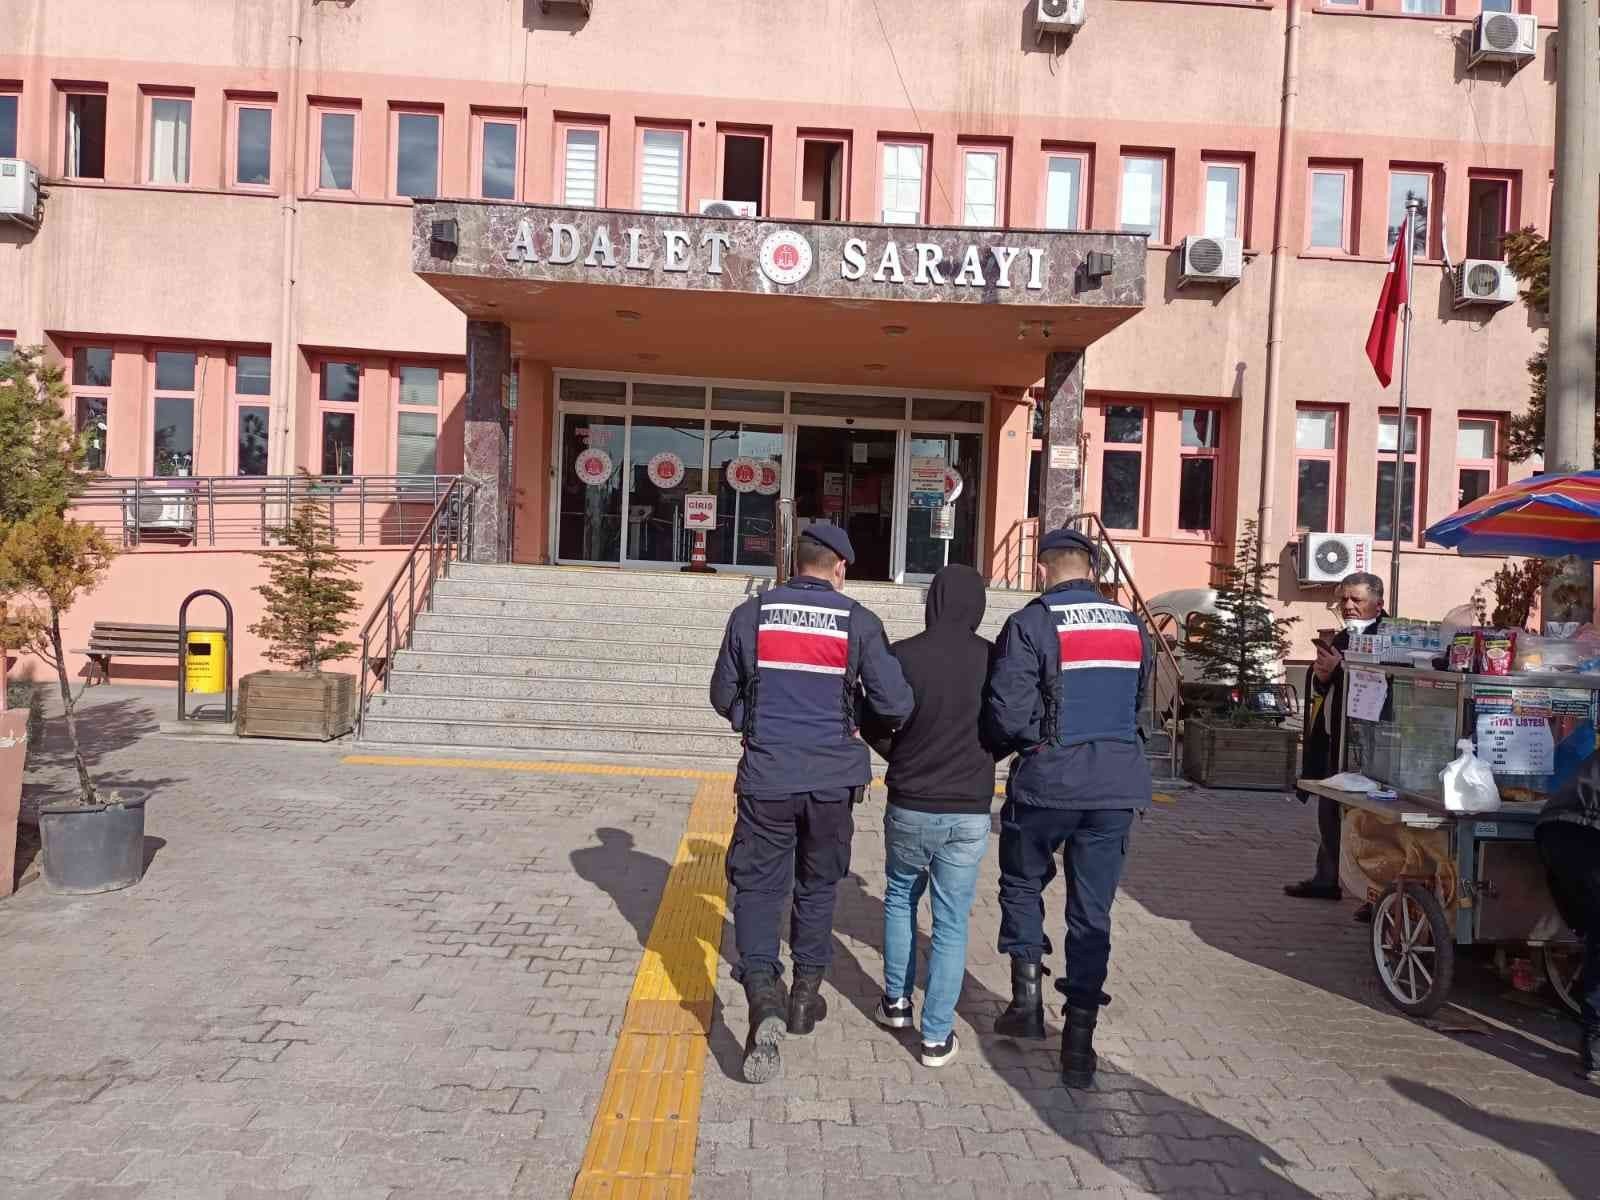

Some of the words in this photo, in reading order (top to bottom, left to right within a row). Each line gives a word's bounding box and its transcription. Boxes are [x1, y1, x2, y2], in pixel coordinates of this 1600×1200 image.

[506, 219, 731, 275] ADALET
[840, 237, 1045, 290] SARAYI
[765, 607, 838, 630] JANDARMA
[1062, 607, 1130, 625] JANDARMA
